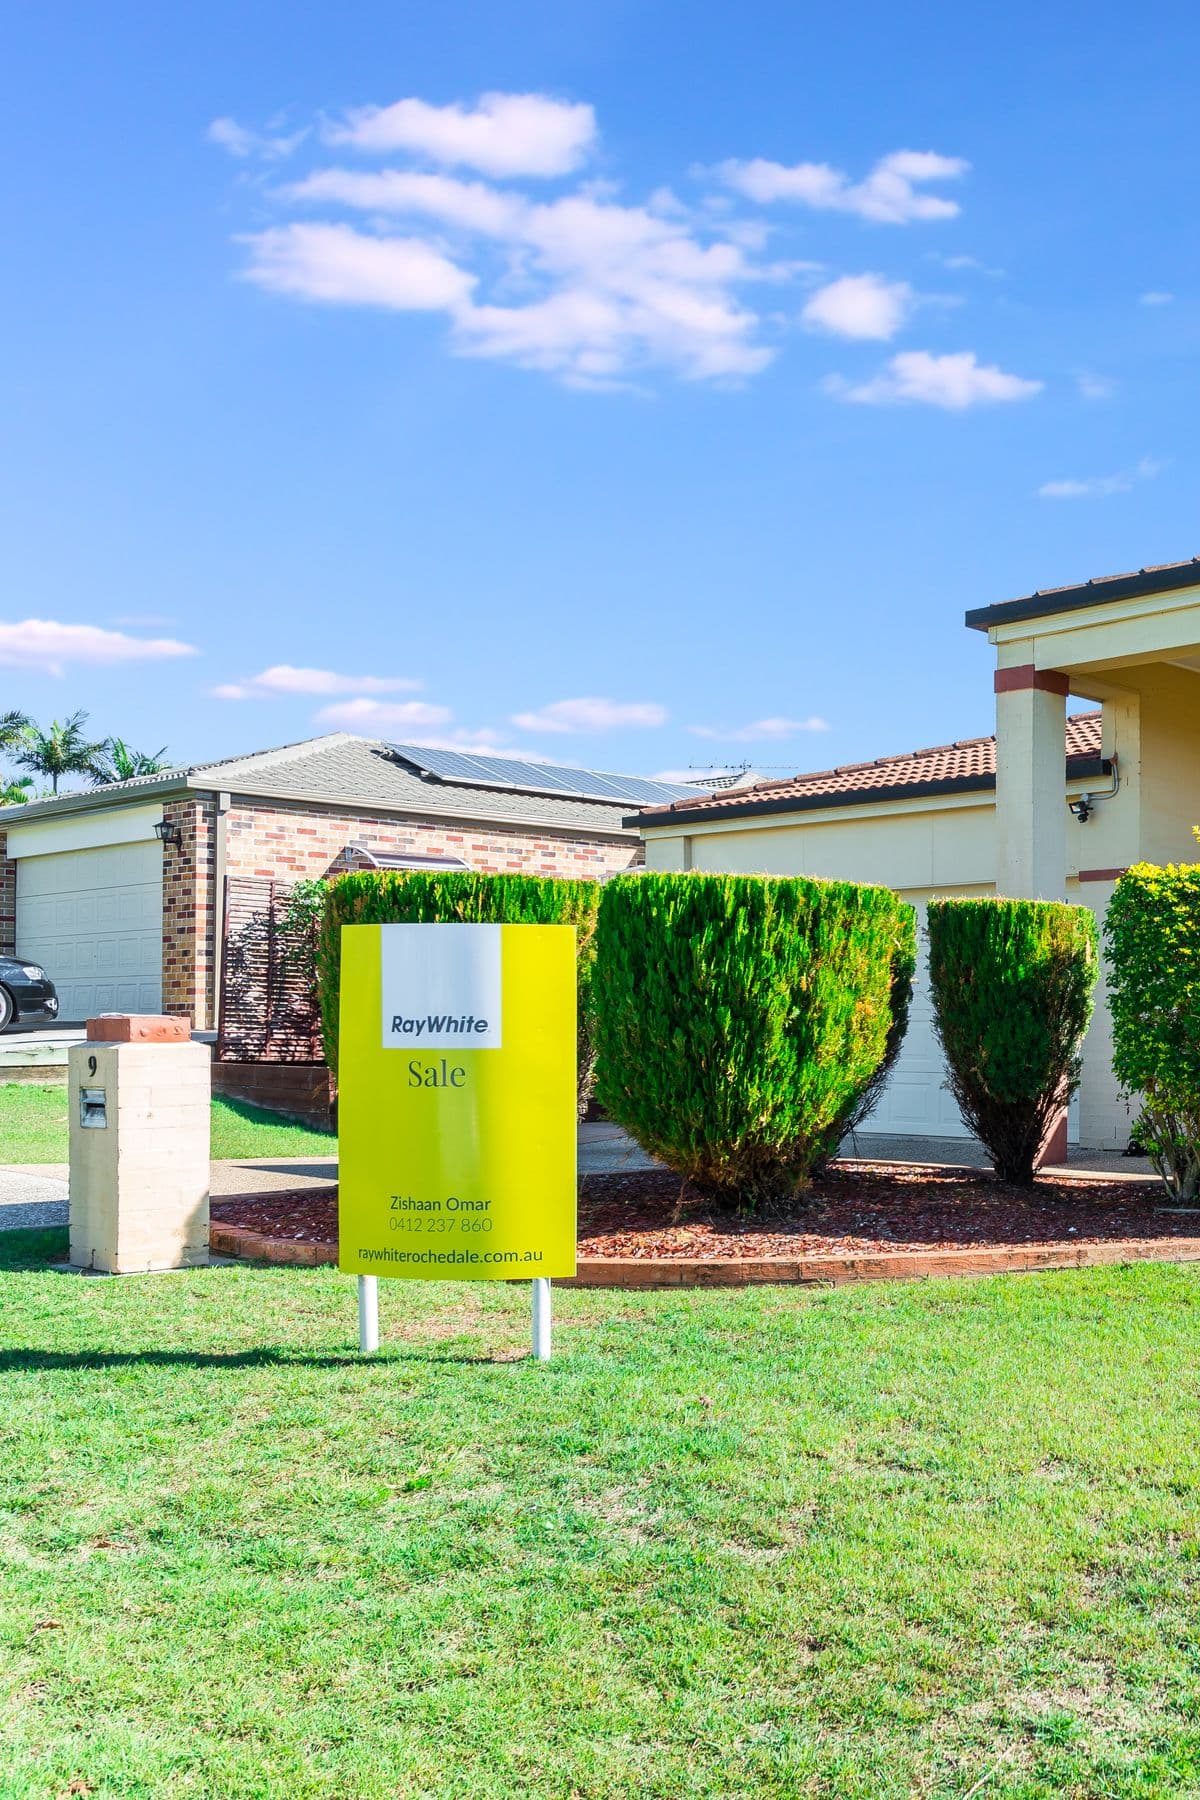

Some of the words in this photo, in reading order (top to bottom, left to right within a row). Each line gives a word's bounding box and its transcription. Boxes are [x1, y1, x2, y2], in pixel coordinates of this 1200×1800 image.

[391, 1015, 489, 1036] RayWhite
[88, 1055, 97, 1077] 9
[408, 1059, 466, 1088] Sale
[390, 1196, 441, 1211] Zishaan
[446, 1197, 492, 1211] Omar
[389, 1217, 423, 1232] 0412
[427, 1218, 455, 1232] 237
[461, 1218, 493, 1232] 860
[358, 1247, 544, 1264] raywhiterochedale.com.au
